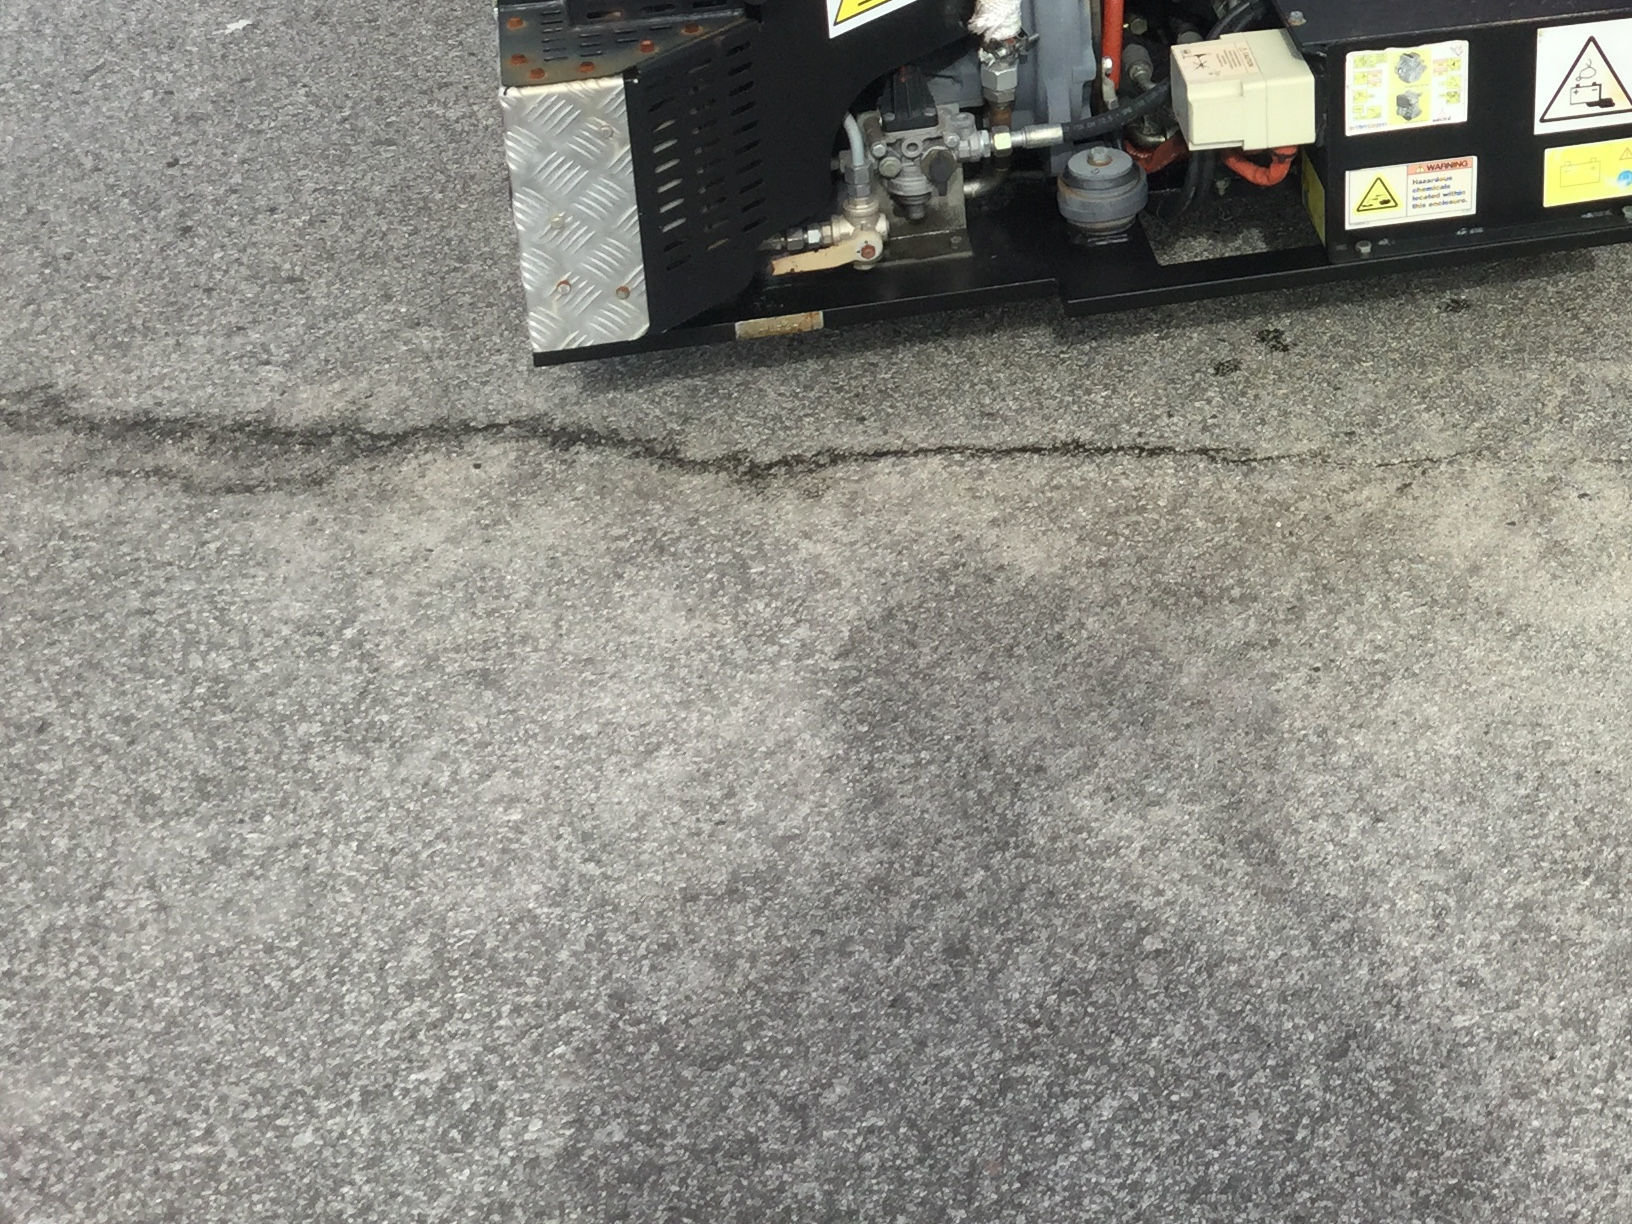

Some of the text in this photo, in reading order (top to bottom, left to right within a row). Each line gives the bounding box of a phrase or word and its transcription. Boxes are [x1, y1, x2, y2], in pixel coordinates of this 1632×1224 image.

[1427, 160, 1468, 171] WARNING
[1412, 176, 1453, 185] Hazardous
[1412, 184, 1451, 193] chemicals
[1412, 192, 1441, 201] located
[1412, 201, 1426, 209] this
